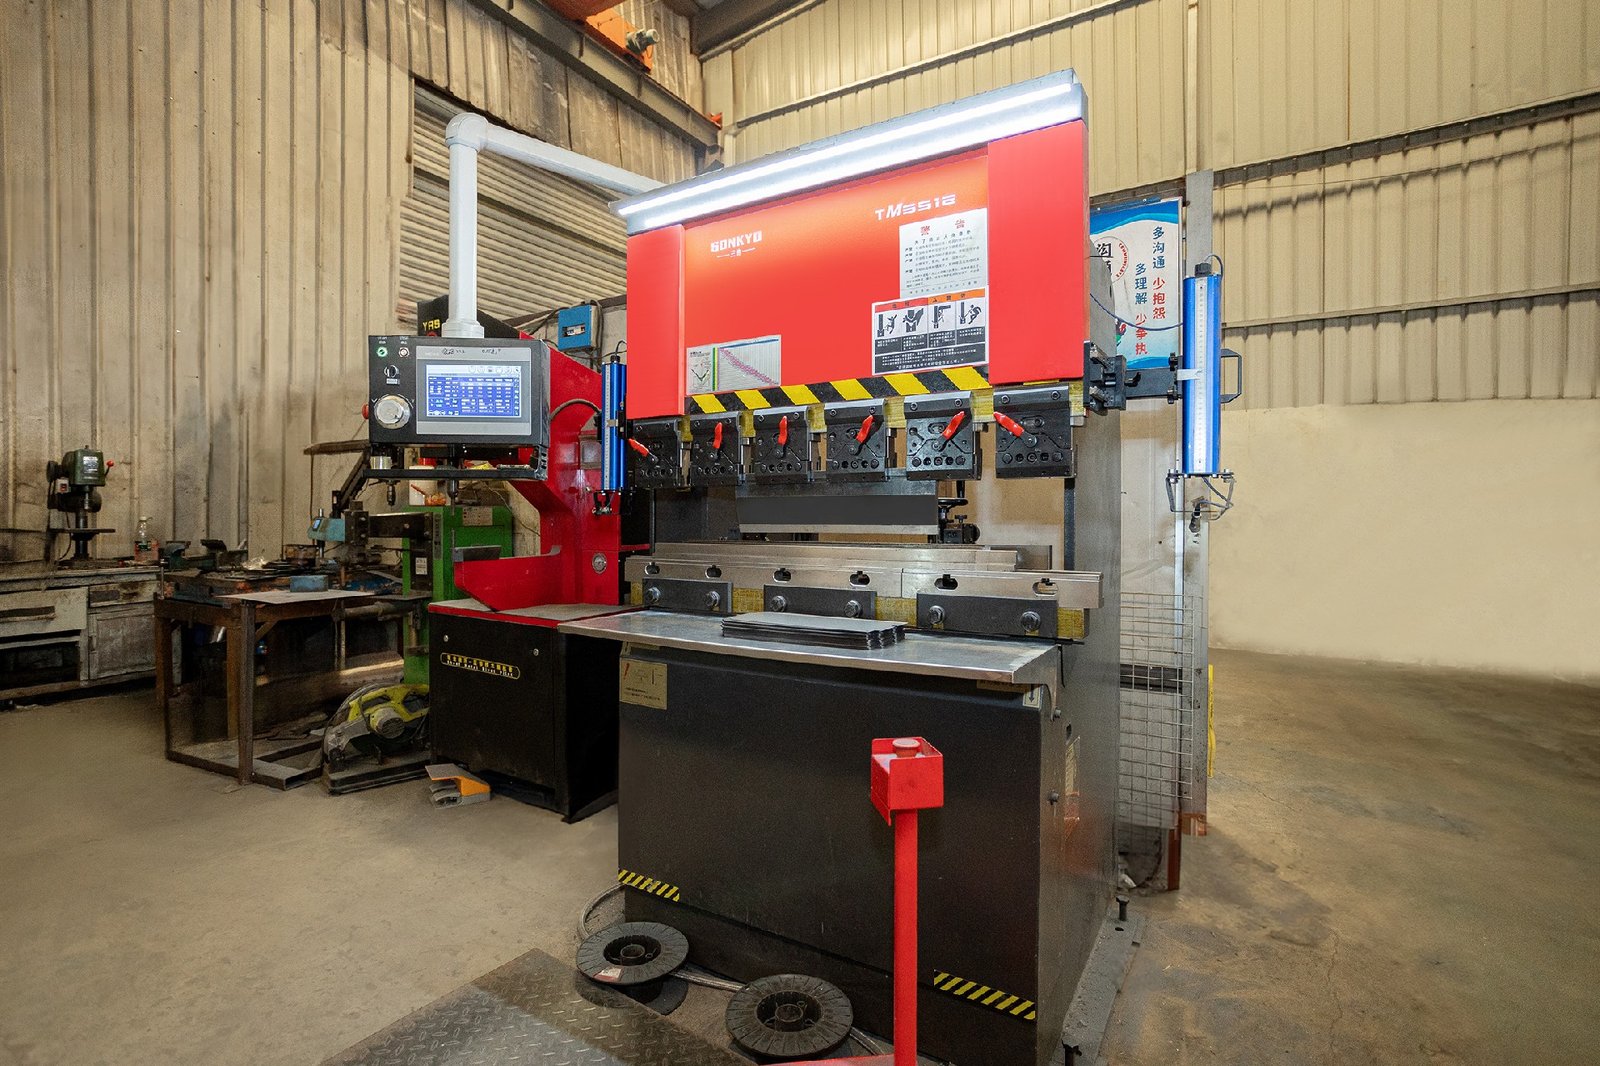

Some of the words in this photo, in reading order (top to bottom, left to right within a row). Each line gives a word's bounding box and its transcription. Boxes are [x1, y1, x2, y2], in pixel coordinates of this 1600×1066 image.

[1152, 226, 1166, 269] 多沟通
[1134, 262, 1148, 306] 多理解
[1152, 276, 1166, 320] 少抱怨
[1134, 313, 1148, 356] 少争执
